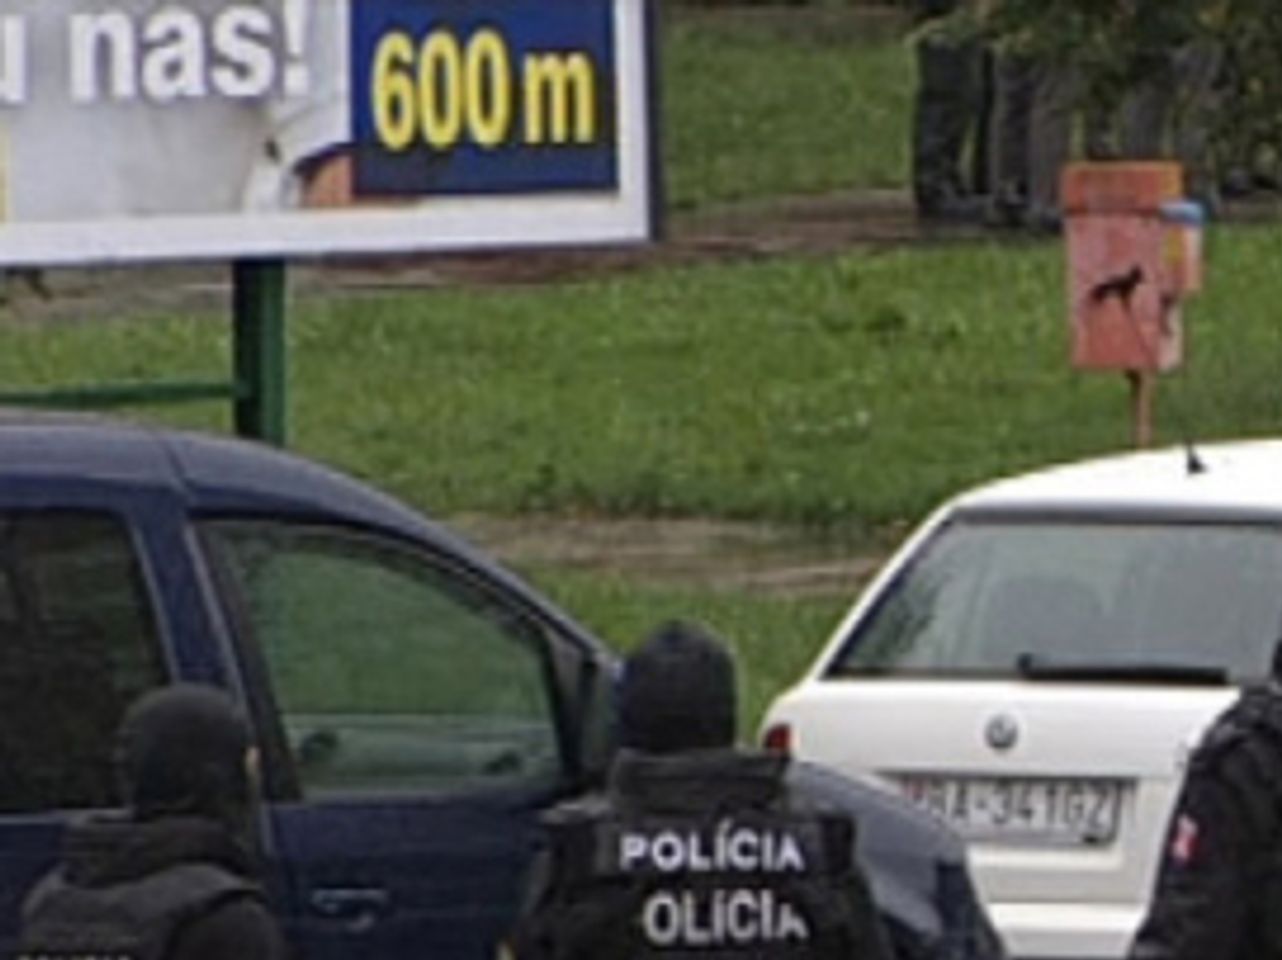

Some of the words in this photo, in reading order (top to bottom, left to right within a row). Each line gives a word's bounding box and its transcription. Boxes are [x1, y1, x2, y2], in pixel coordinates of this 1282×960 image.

[70, 2, 308, 99] nas!
[371, 29, 509, 148] 600
[523, 51, 595, 143] m
[620, 817, 804, 871] POLÍCIA
